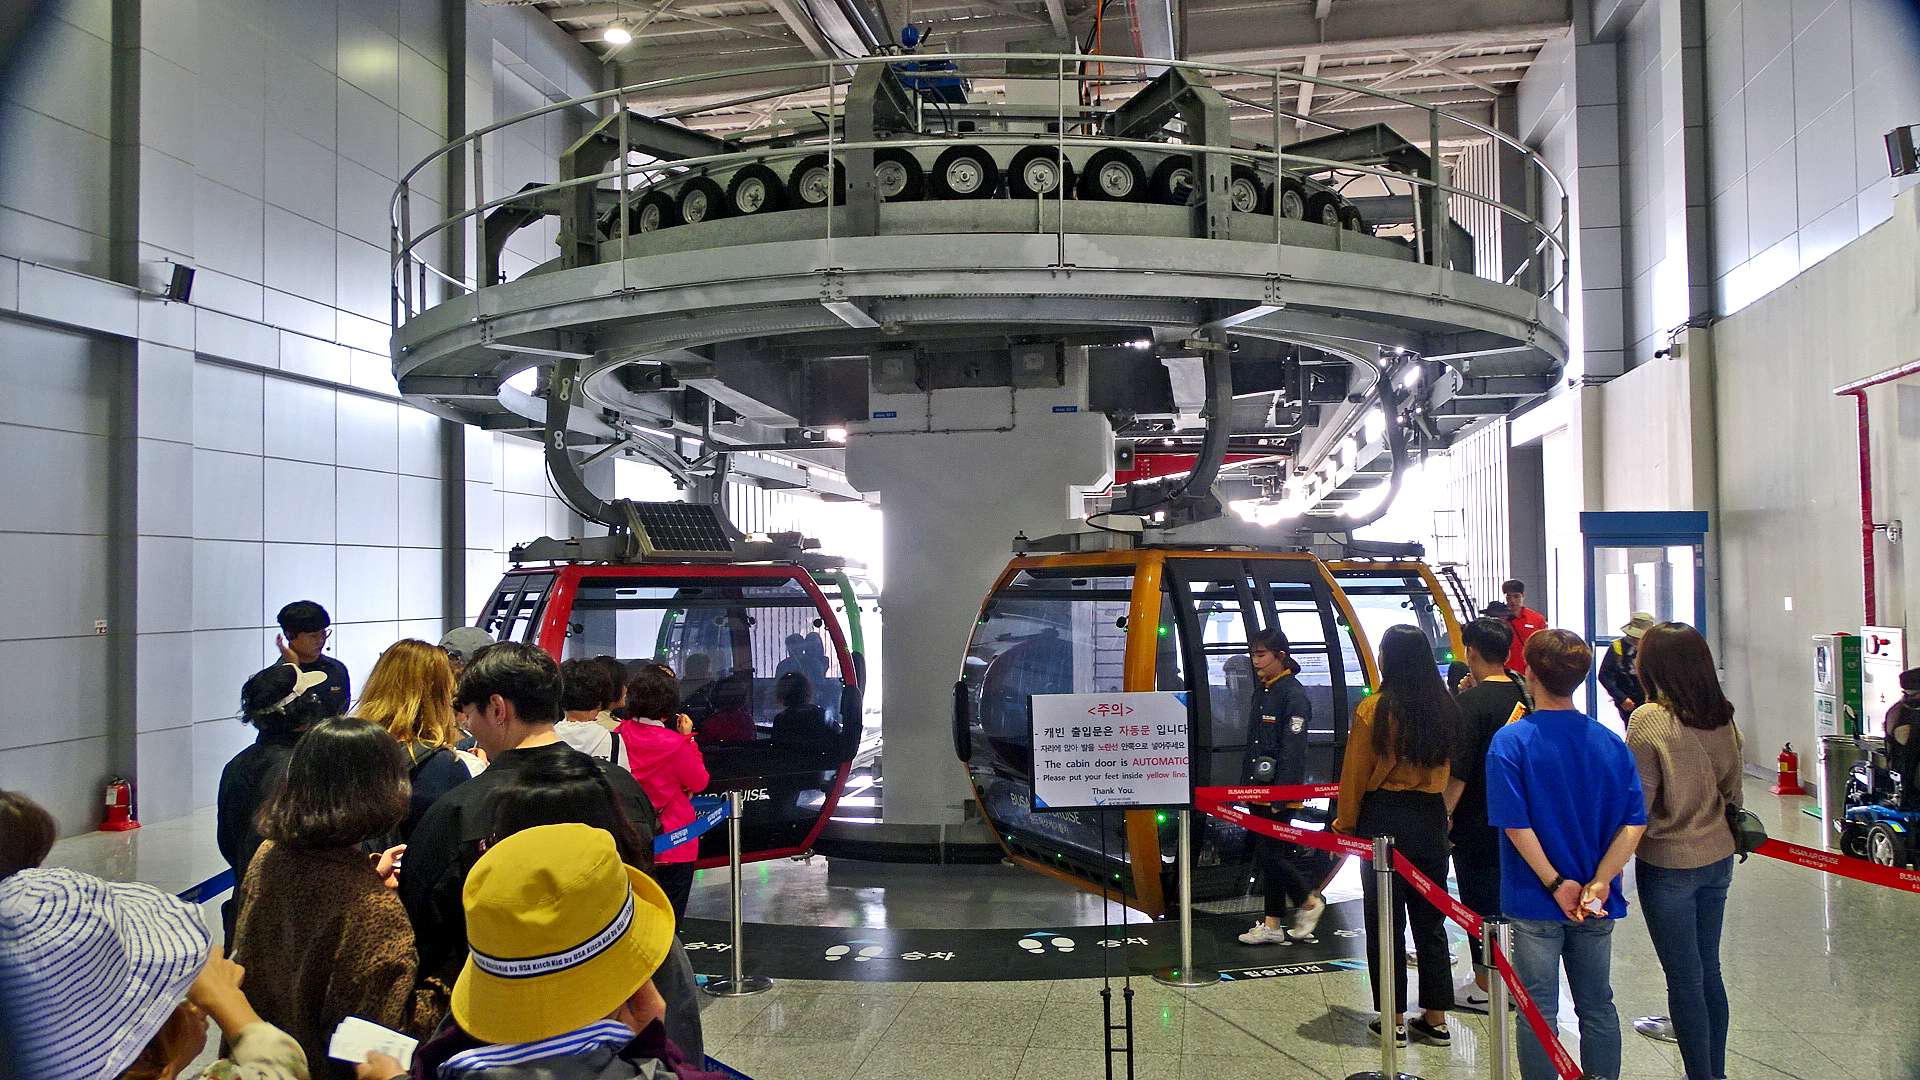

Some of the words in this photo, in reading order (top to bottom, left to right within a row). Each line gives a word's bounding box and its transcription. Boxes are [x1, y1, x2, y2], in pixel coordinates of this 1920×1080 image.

[1044, 727, 1065, 738] 캐빈
[1071, 726, 1113, 737] 출입문은
[1119, 725, 1150, 736] 자동문
[1156, 724, 1188, 735] 입니다
[1040, 744, 1061, 752] 자리에
[1081, 743, 1095, 752] 발을
[1097, 743, 1118, 752] 노란선
[1121, 742, 1149, 751] 안쪽으로
[1151, 741, 1185, 751] 넣어주세요
[1044, 760, 1062, 768] The
[1066, 759, 1090, 768] cabin
[1095, 758, 1117, 767] door
[1121, 758, 1128, 767] is
[1132, 756, 1189, 766] AUTOMATIC
[1069, 774, 1082, 783] put
[1084, 774, 1102, 782] your
[1146, 771, 1170, 780] yellow
[1091, 787, 1115, 795] Thank
[532, 961, 551, 970] Kitch
[551, 959, 563, 967] Kid
[563, 956, 573, 964] by
[573, 949, 586, 960] USA
[900, 951, 956, 961] 승차
